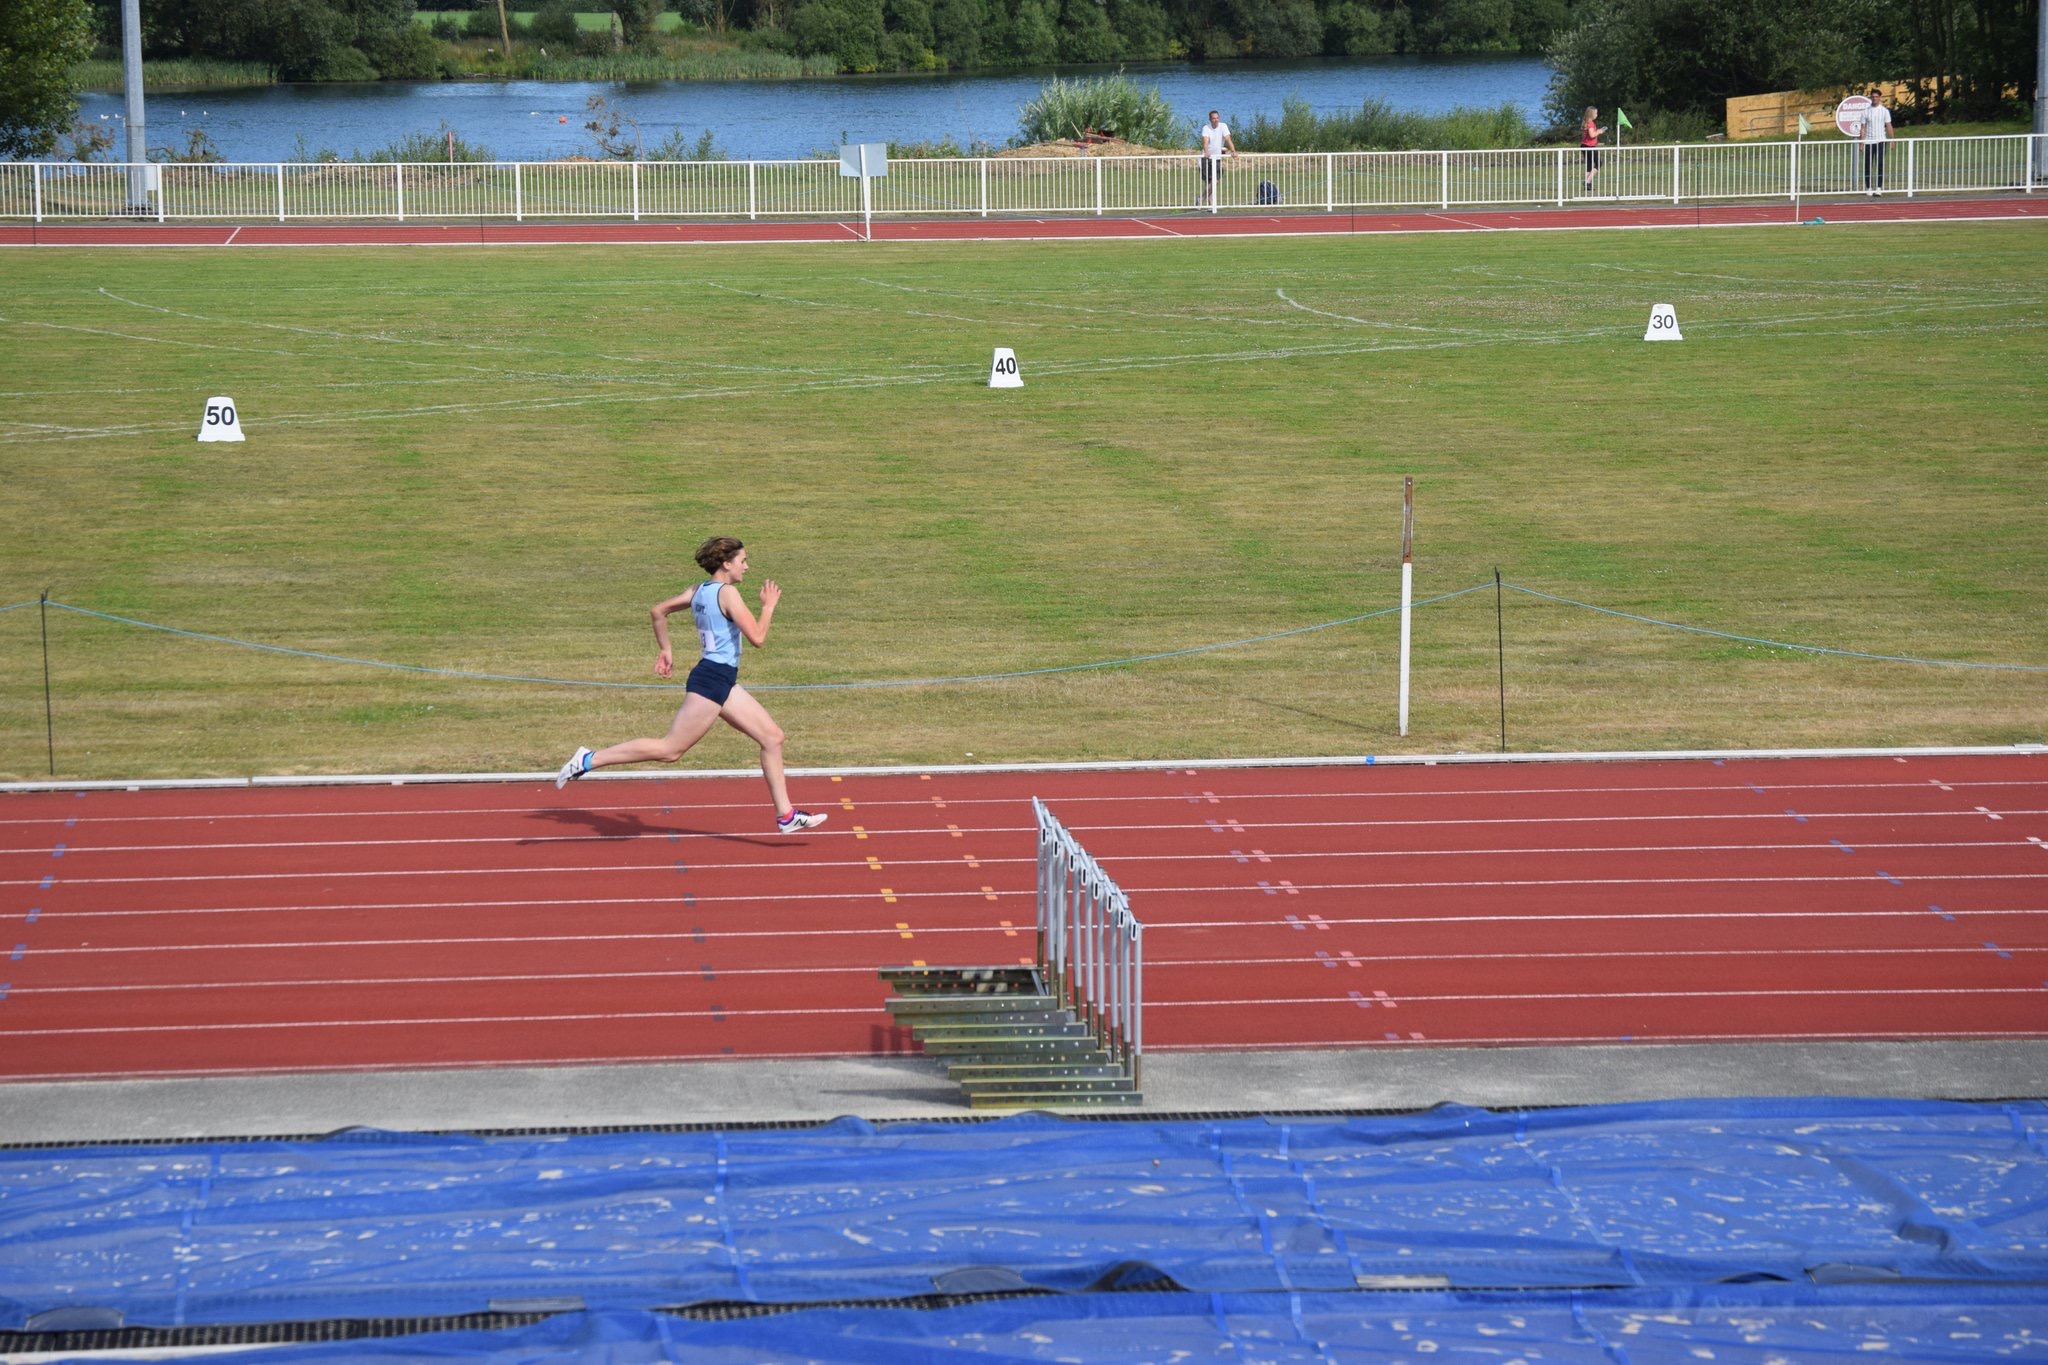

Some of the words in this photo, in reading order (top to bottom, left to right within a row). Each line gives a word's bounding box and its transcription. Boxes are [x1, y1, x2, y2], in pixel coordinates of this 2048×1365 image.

[1652, 314, 1674, 329] 30
[995, 357, 1017, 375] 40
[206, 405, 235, 426] 50
